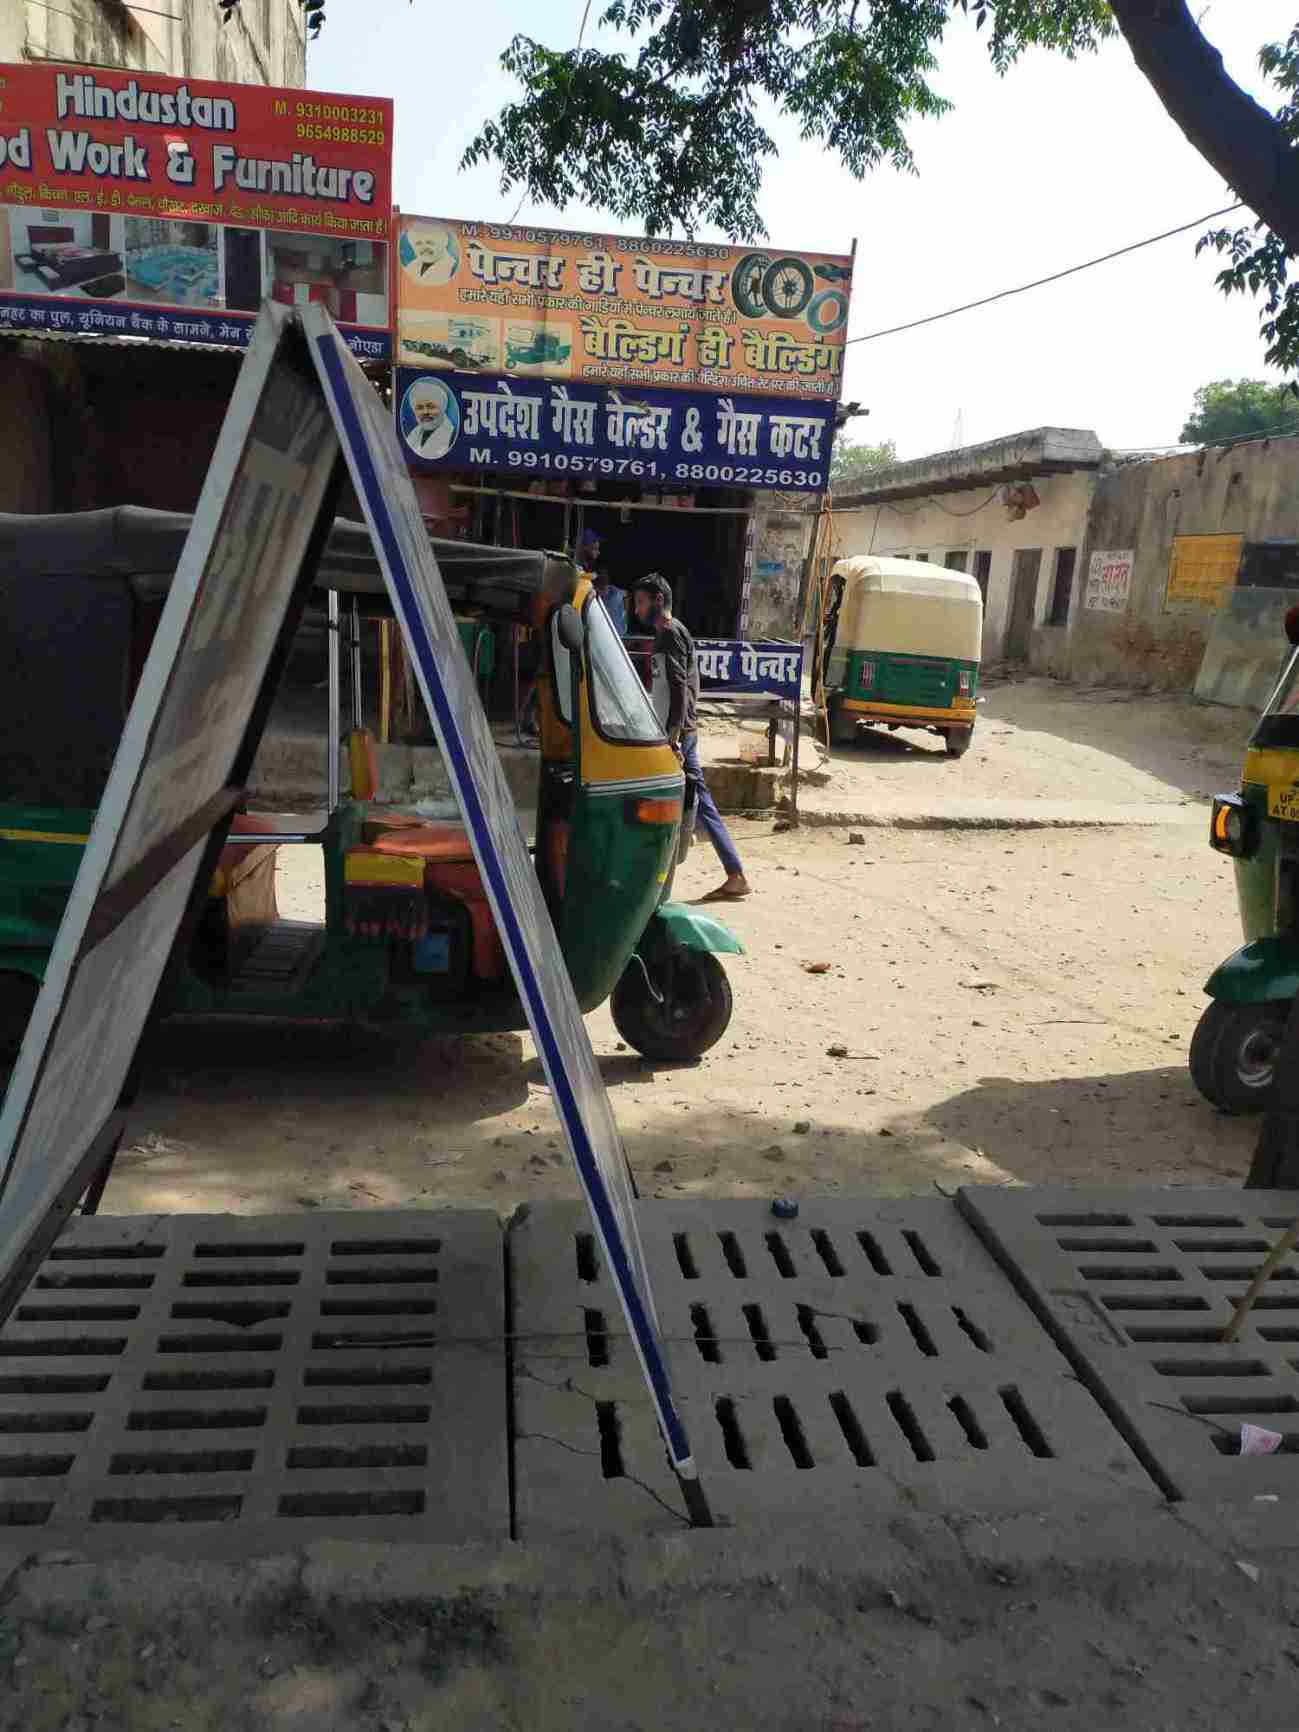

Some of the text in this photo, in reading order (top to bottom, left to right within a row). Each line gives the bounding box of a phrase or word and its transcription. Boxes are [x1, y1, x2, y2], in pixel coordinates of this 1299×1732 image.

[56, 73, 236, 131] Hindustan
[296, 123, 385, 145] 9654988529
[46, 129, 150, 183] Work
[166, 141, 196, 185] &
[211, 144, 375, 204] Furniture
[575, 249, 624, 297] ही
[696, 326, 734, 369] ही
[461, 381, 544, 440] उपदेश
[550, 385, 598, 445] गैस
[681, 407, 703, 452] &
[716, 398, 762, 457] गैस
[769, 415, 826, 460] कटर
[469, 447, 498, 464] M.
[675, 463, 822, 487] 8800225630
